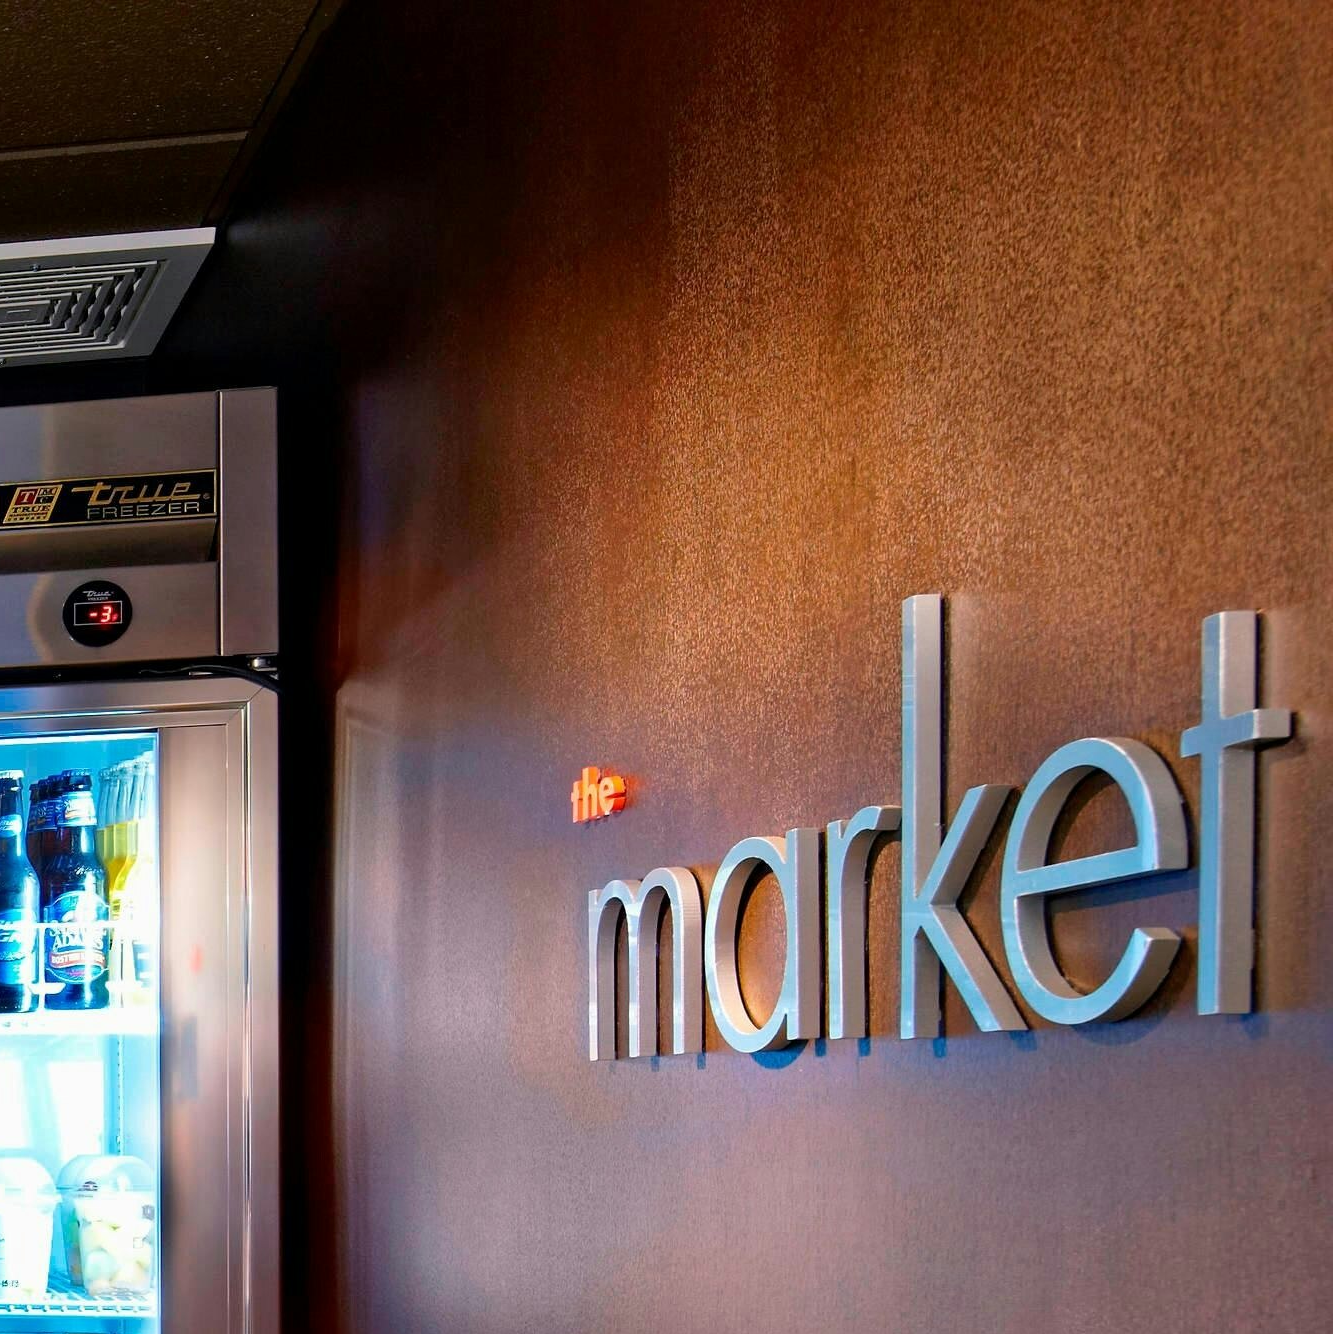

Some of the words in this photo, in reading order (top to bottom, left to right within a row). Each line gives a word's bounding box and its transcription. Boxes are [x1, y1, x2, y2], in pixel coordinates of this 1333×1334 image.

[72, 482, 200, 505] true
[11, 505, 50, 513] TRUE
[87, 502, 200, 519] FREEZER
[89, 607, 112, 622] -3
[571, 767, 627, 822] the
[588, 592, 1293, 1064] market
